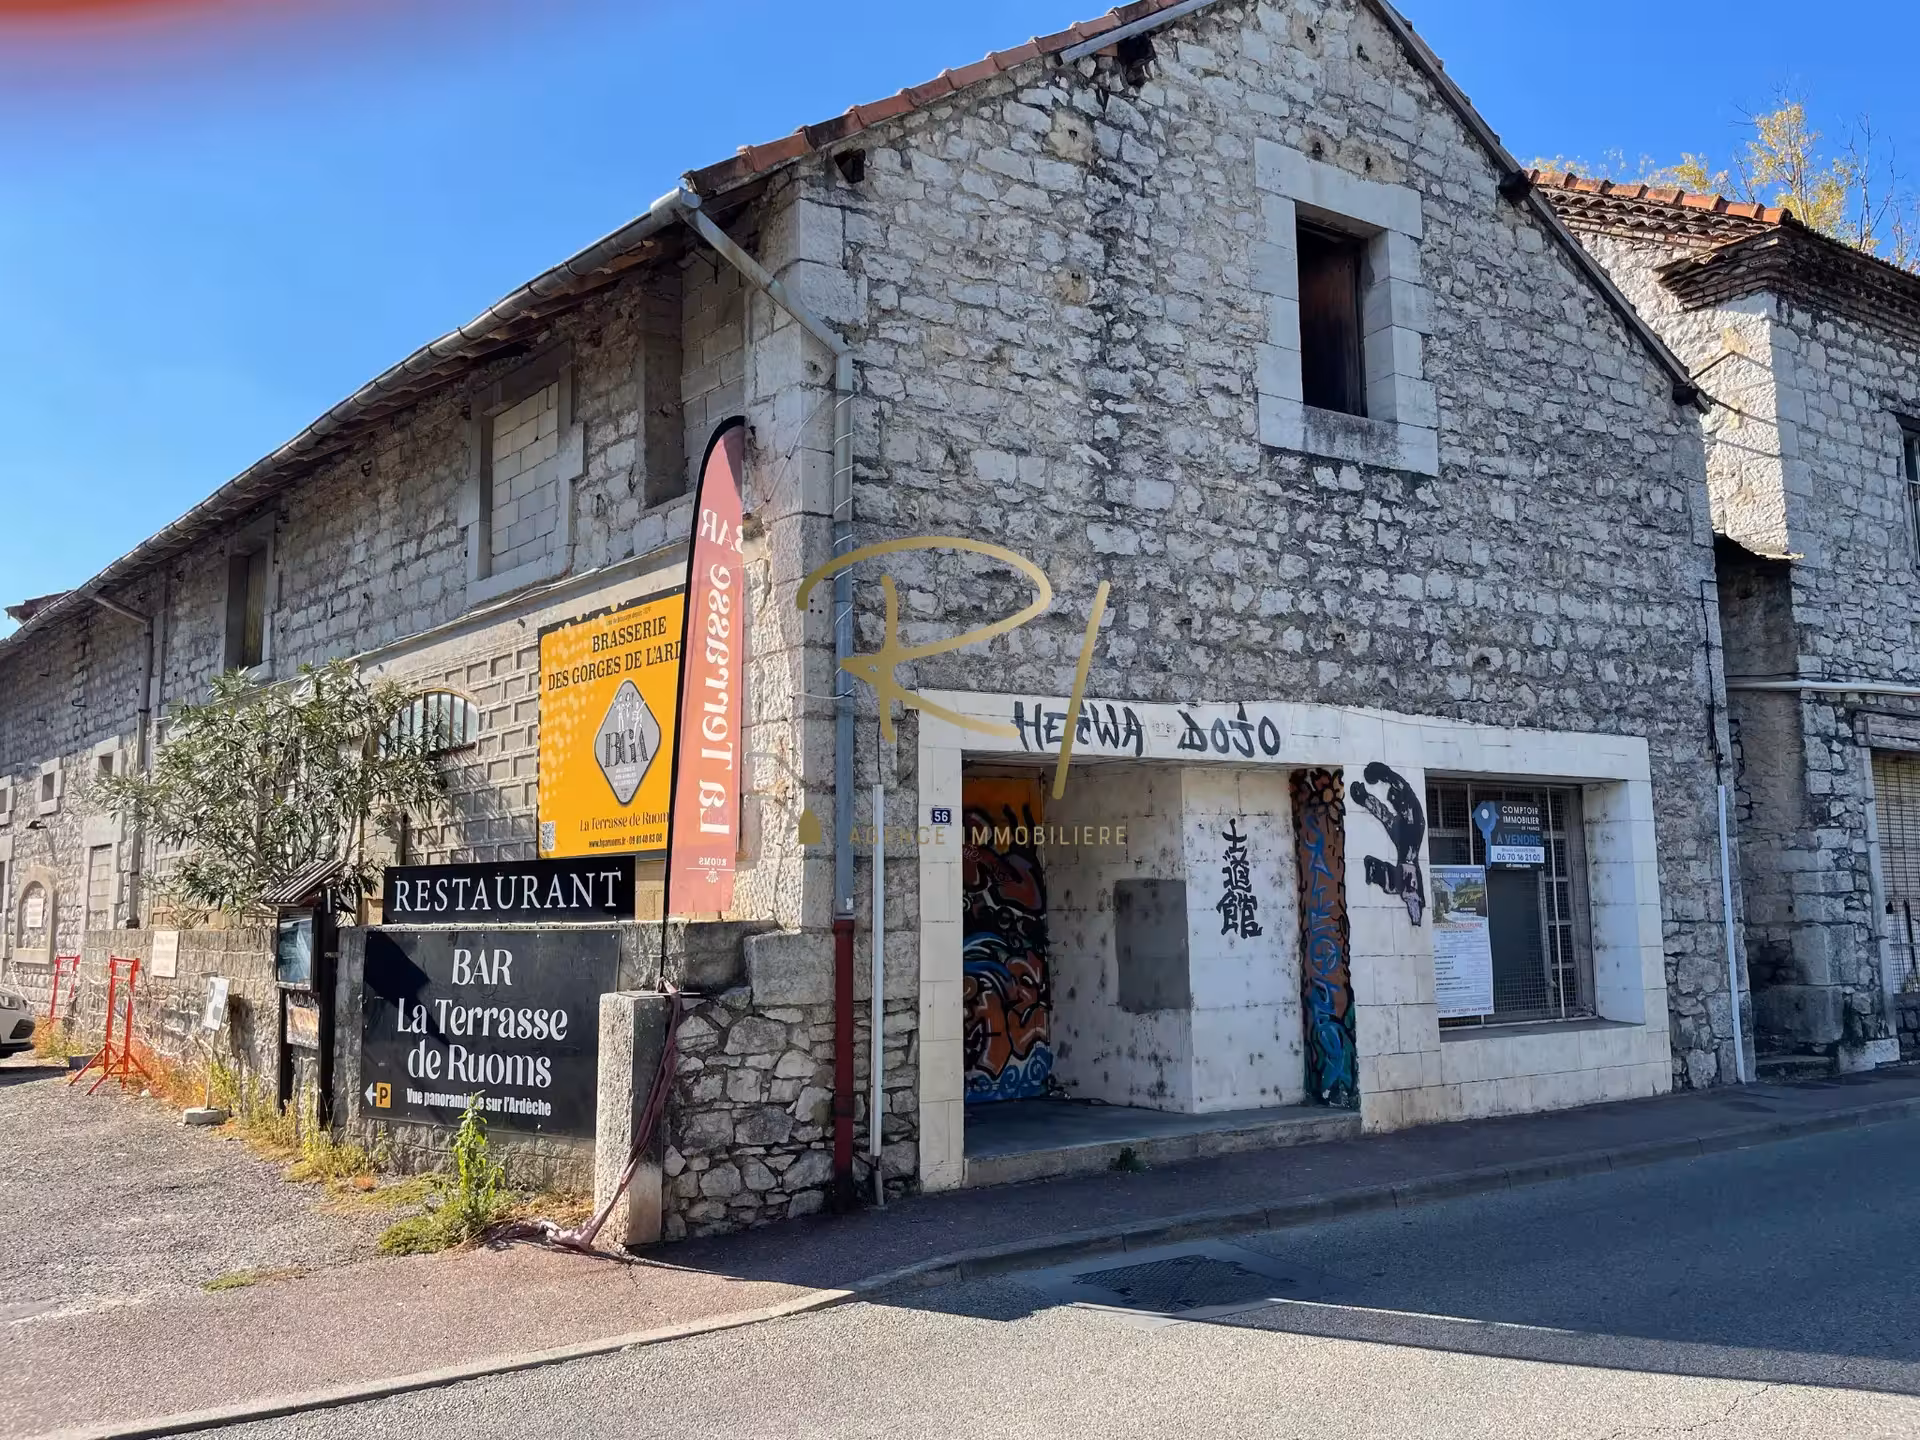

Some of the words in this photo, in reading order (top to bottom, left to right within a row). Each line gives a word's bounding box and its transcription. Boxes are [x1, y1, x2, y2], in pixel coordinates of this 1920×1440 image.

[592, 616, 667, 653] BRASSERIE
[548, 670, 569, 691] DES
[572, 656, 621, 684] GORGES
[625, 651, 642, 671] DE
[605, 728, 649, 767] BGA
[1177, 702, 1281, 758] DOJO
[580, 820, 589, 832] La
[592, 816, 627, 830] Terrasse
[629, 812, 640, 826] de
[935, 811, 948, 822] 56
[1502, 806, 1539, 814] COMPTOIR
[1503, 816, 1540, 824] IMMOBILIER
[1505, 834, 1541, 845] VENDRE
[393, 870, 621, 911] RESTAURANT
[452, 949, 513, 985] BAR
[397, 998, 427, 1034] La
[435, 999, 568, 1041] Terrasse
[408, 1039, 441, 1080] de
[448, 1044, 552, 1088] Ruoms
[378, 1086, 388, 1104] P
[407, 1088, 423, 1104] Vue
[424, 1092, 484, 1110] panoramie
[486, 1097, 502, 1112] sur
[504, 1097, 551, 1116] l'Ardèche
